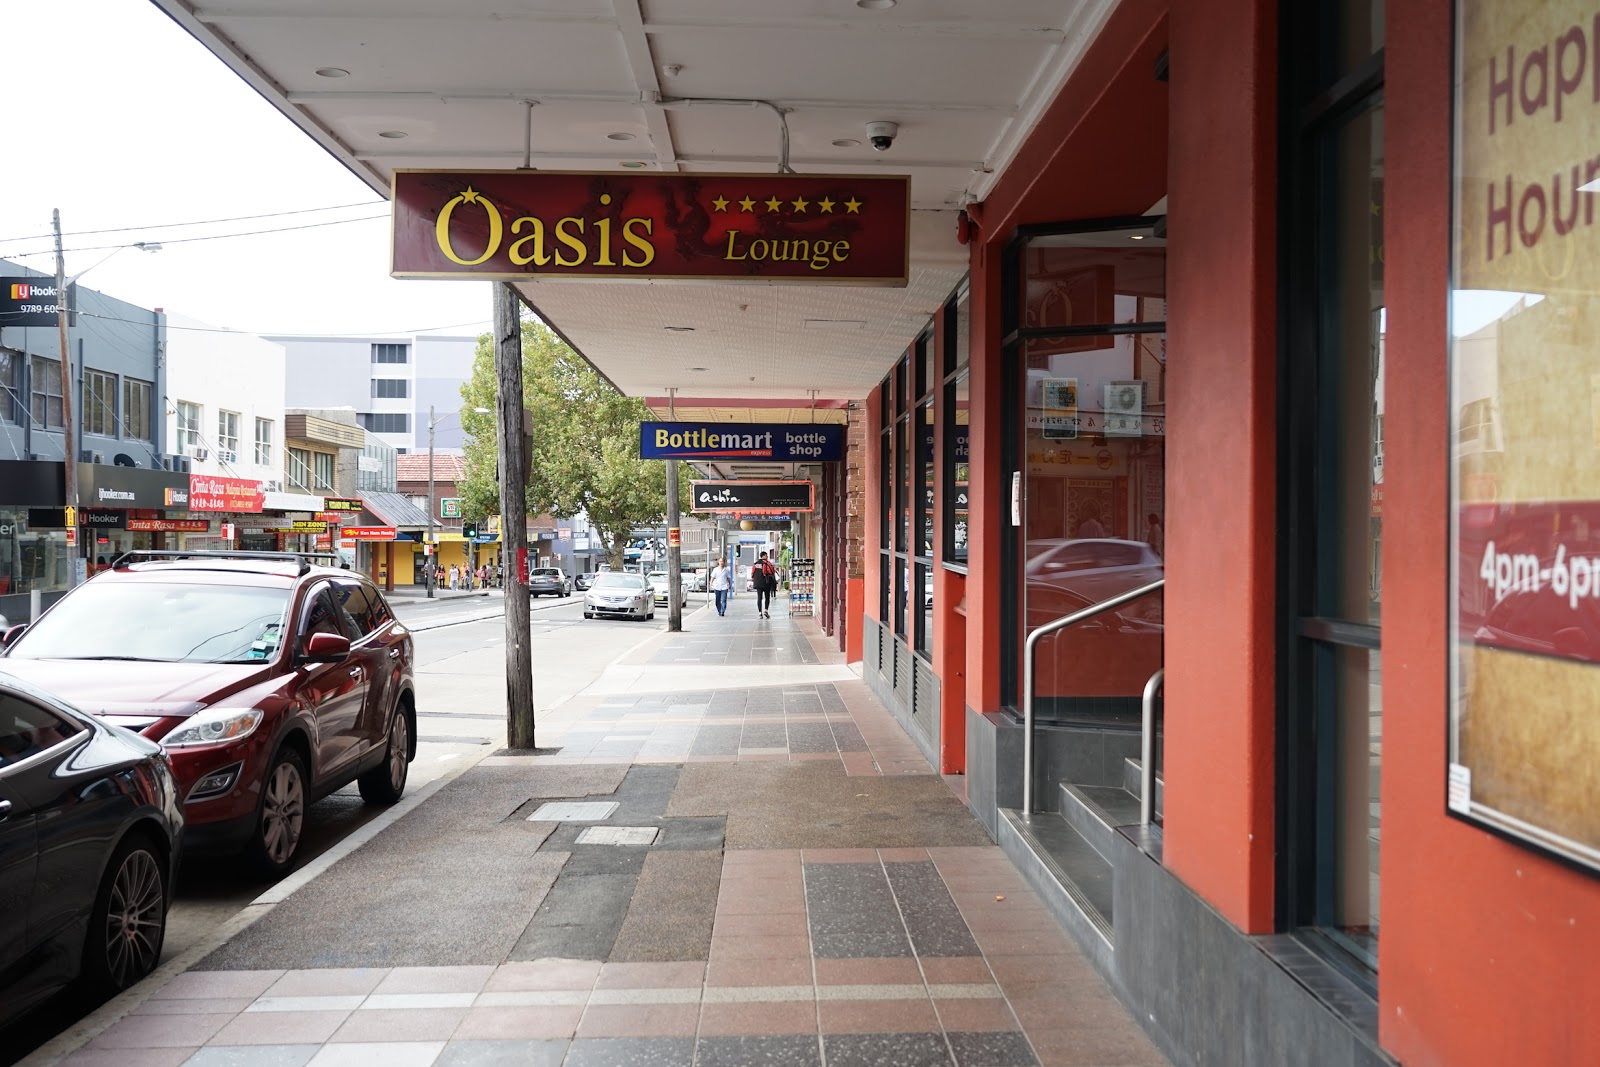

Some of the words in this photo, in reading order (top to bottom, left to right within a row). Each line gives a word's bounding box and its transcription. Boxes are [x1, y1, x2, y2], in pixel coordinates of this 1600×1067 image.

[435, 190, 655, 267] Oasis
[722, 229, 850, 270] Lounge
[20, 304, 42, 314] 9789
[655, 428, 773, 449] Bottlemart
[785, 432, 827, 444] bottle
[789, 444, 822, 457] shop
[191, 478, 208, 494] Cinta
[208, 480, 224, 497] Rasa
[98, 488, 135, 501] ljhooker.com.au
[173, 490, 188, 502] Hooker
[88, 514, 119, 523] Hooker
[232, 519, 252, 527] Cherry
[253, 519, 273, 527] Beauty
[152, 520, 175, 531] Rasa
